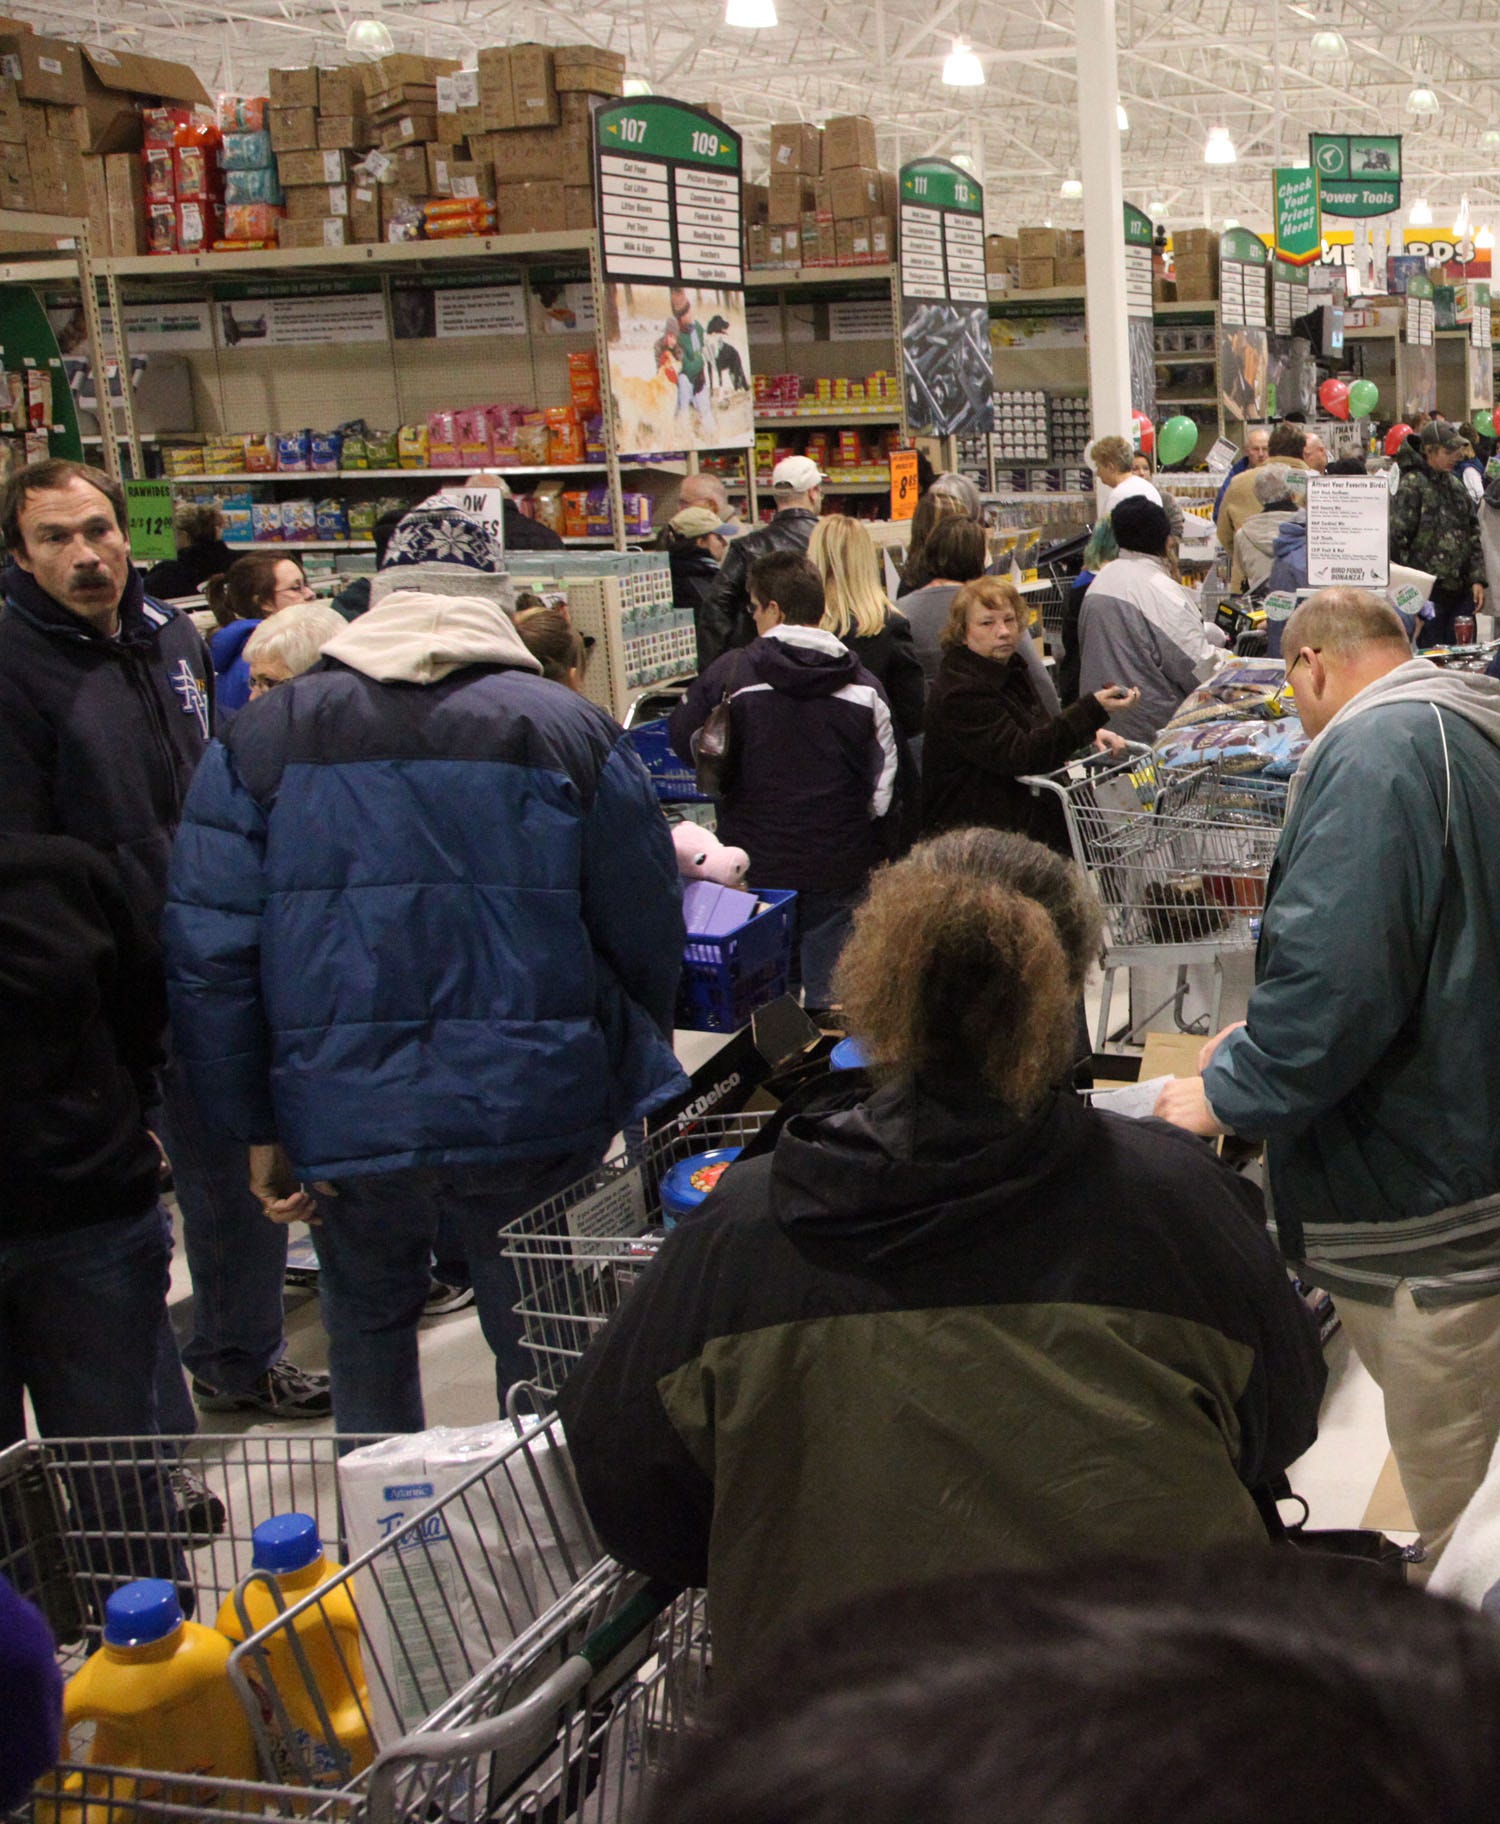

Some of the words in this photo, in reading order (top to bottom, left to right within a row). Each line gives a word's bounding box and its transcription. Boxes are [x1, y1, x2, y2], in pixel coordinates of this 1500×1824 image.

[620, 118, 647, 143] 107
[692, 131, 718, 156] 109
[914, 176, 928, 195] 111
[954, 183, 968, 202] 113
[1278, 176, 1312, 198] Check
[1284, 193, 1309, 209] Your
[1320, 190, 1358, 204] Power
[1362, 190, 1394, 204] Tools
[1280, 206, 1315, 225] Prices
[1283, 217, 1314, 237] Here!
[128, 486, 170, 497] RAWHIDES
[464, 494, 487, 512] OW
[678, 1072, 741, 1132] ACDelco
